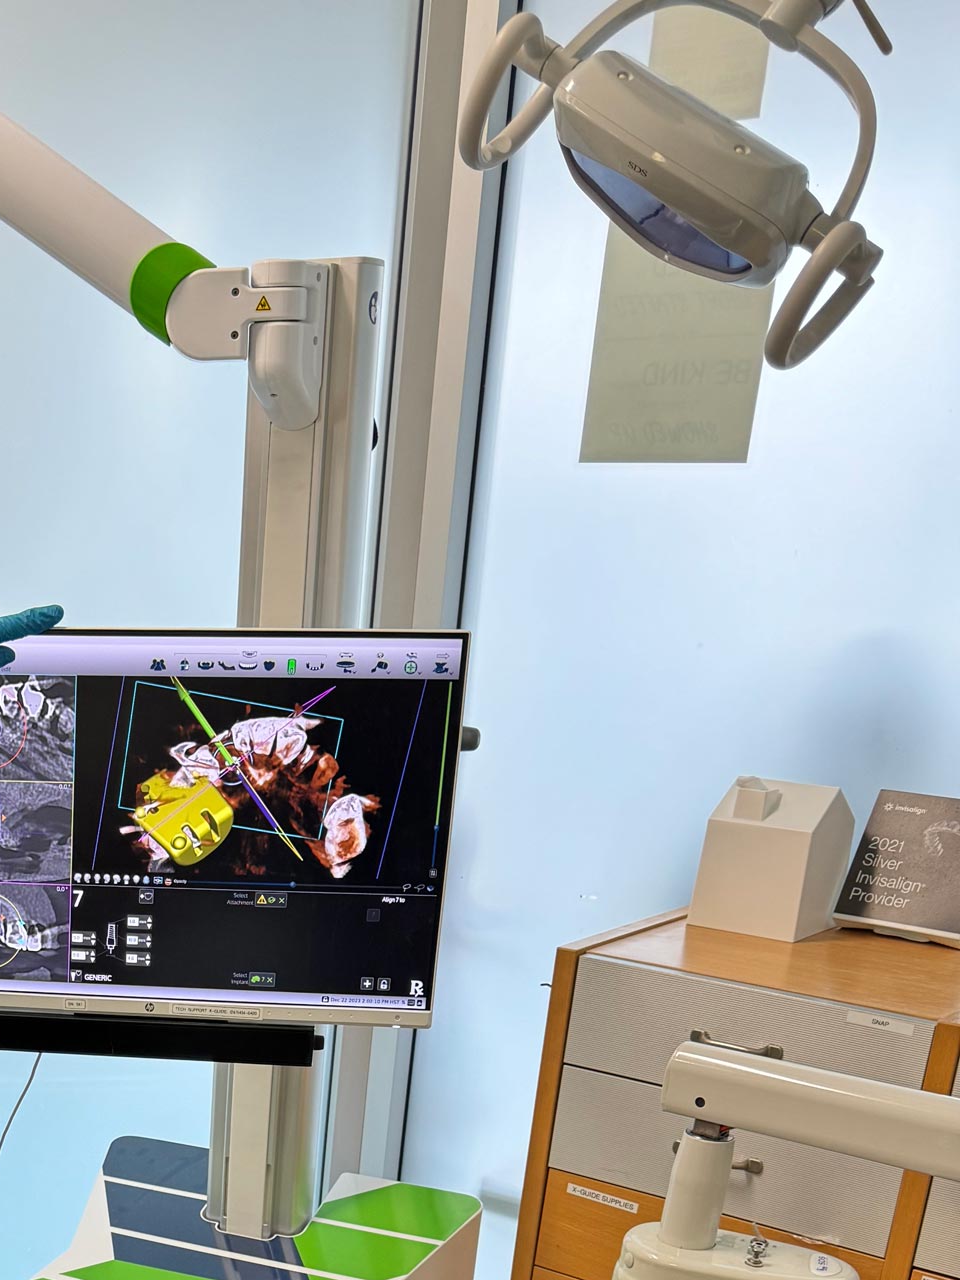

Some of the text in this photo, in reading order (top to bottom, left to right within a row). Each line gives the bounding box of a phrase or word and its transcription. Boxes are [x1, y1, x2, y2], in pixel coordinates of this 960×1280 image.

[628, 161, 648, 177] SDS
[868, 836, 905, 853] 2021
[862, 853, 903, 871] Silver
[72, 890, 84, 908] 7
[849, 887, 910, 908] Provider
[84, 973, 112, 982] GENERIC
[871, 1018, 890, 1027] SNAP
[571, 1186, 634, 1211] X-GUIDE SUPPLIES
